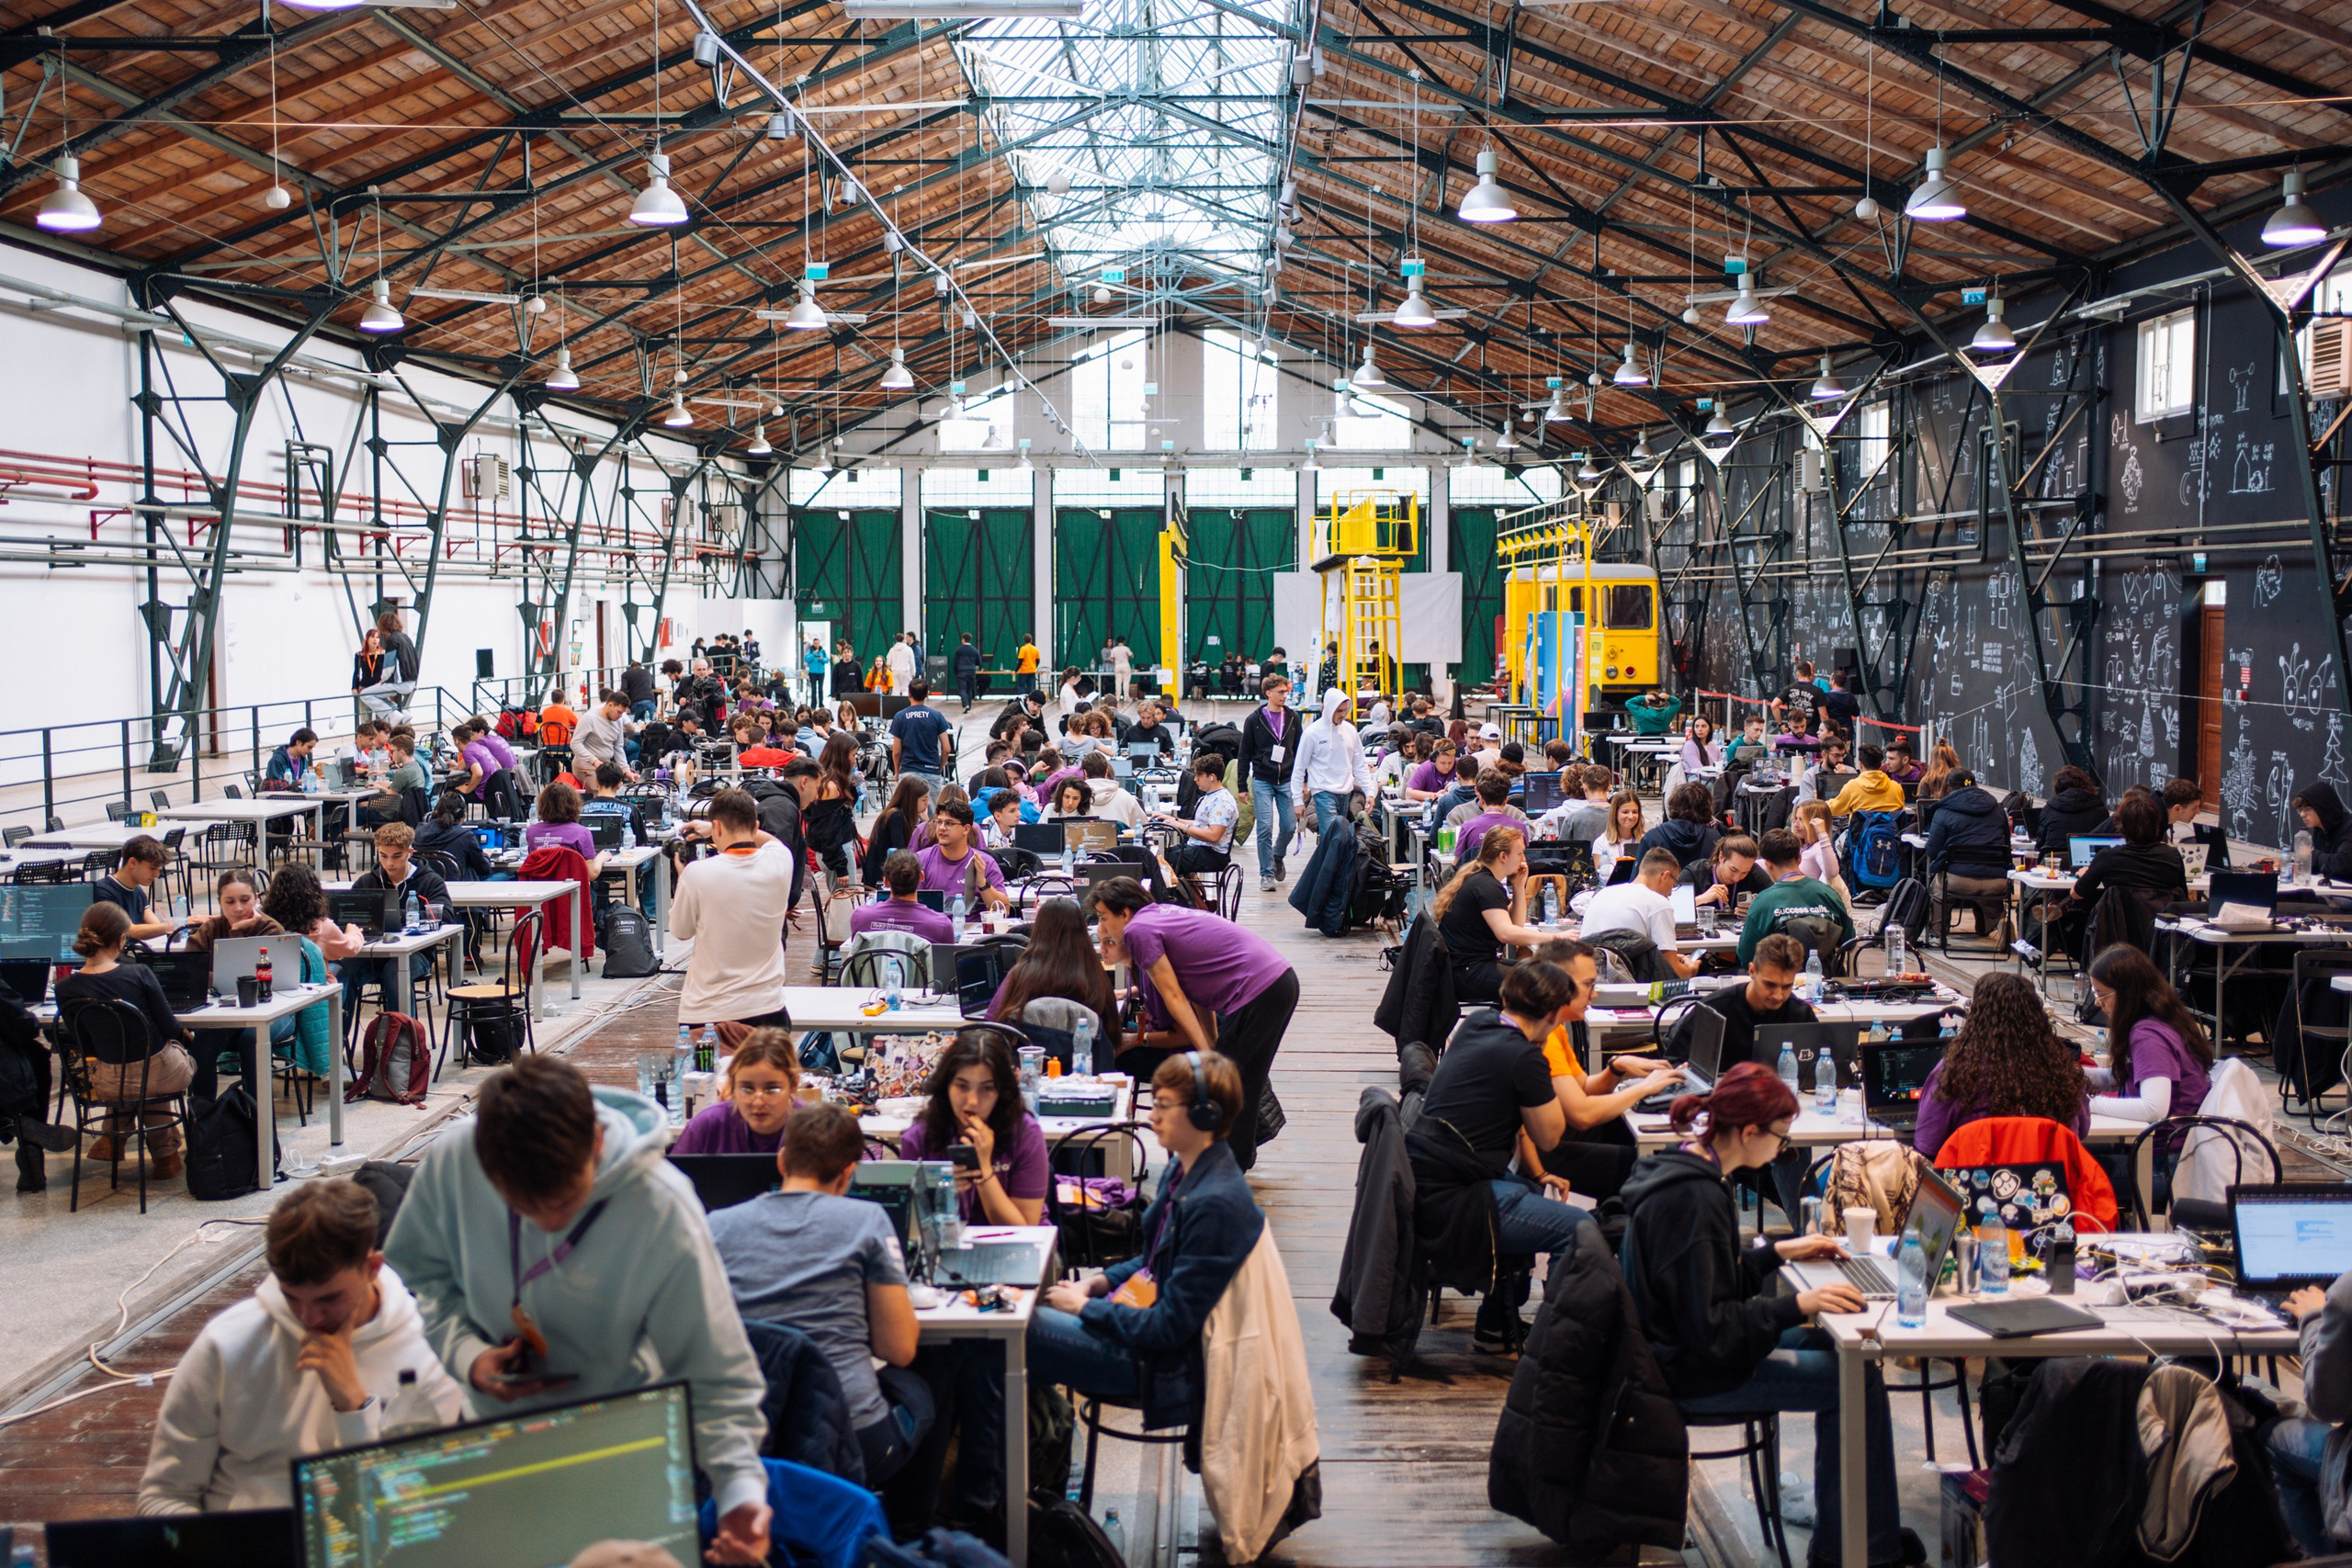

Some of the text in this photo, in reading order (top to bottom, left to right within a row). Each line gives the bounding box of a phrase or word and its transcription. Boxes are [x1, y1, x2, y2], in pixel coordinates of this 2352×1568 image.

[1801, 691, 1815, 700] YORK
[905, 710, 930, 719] UPRETY
[1774, 905, 1829, 917] Success calls.
